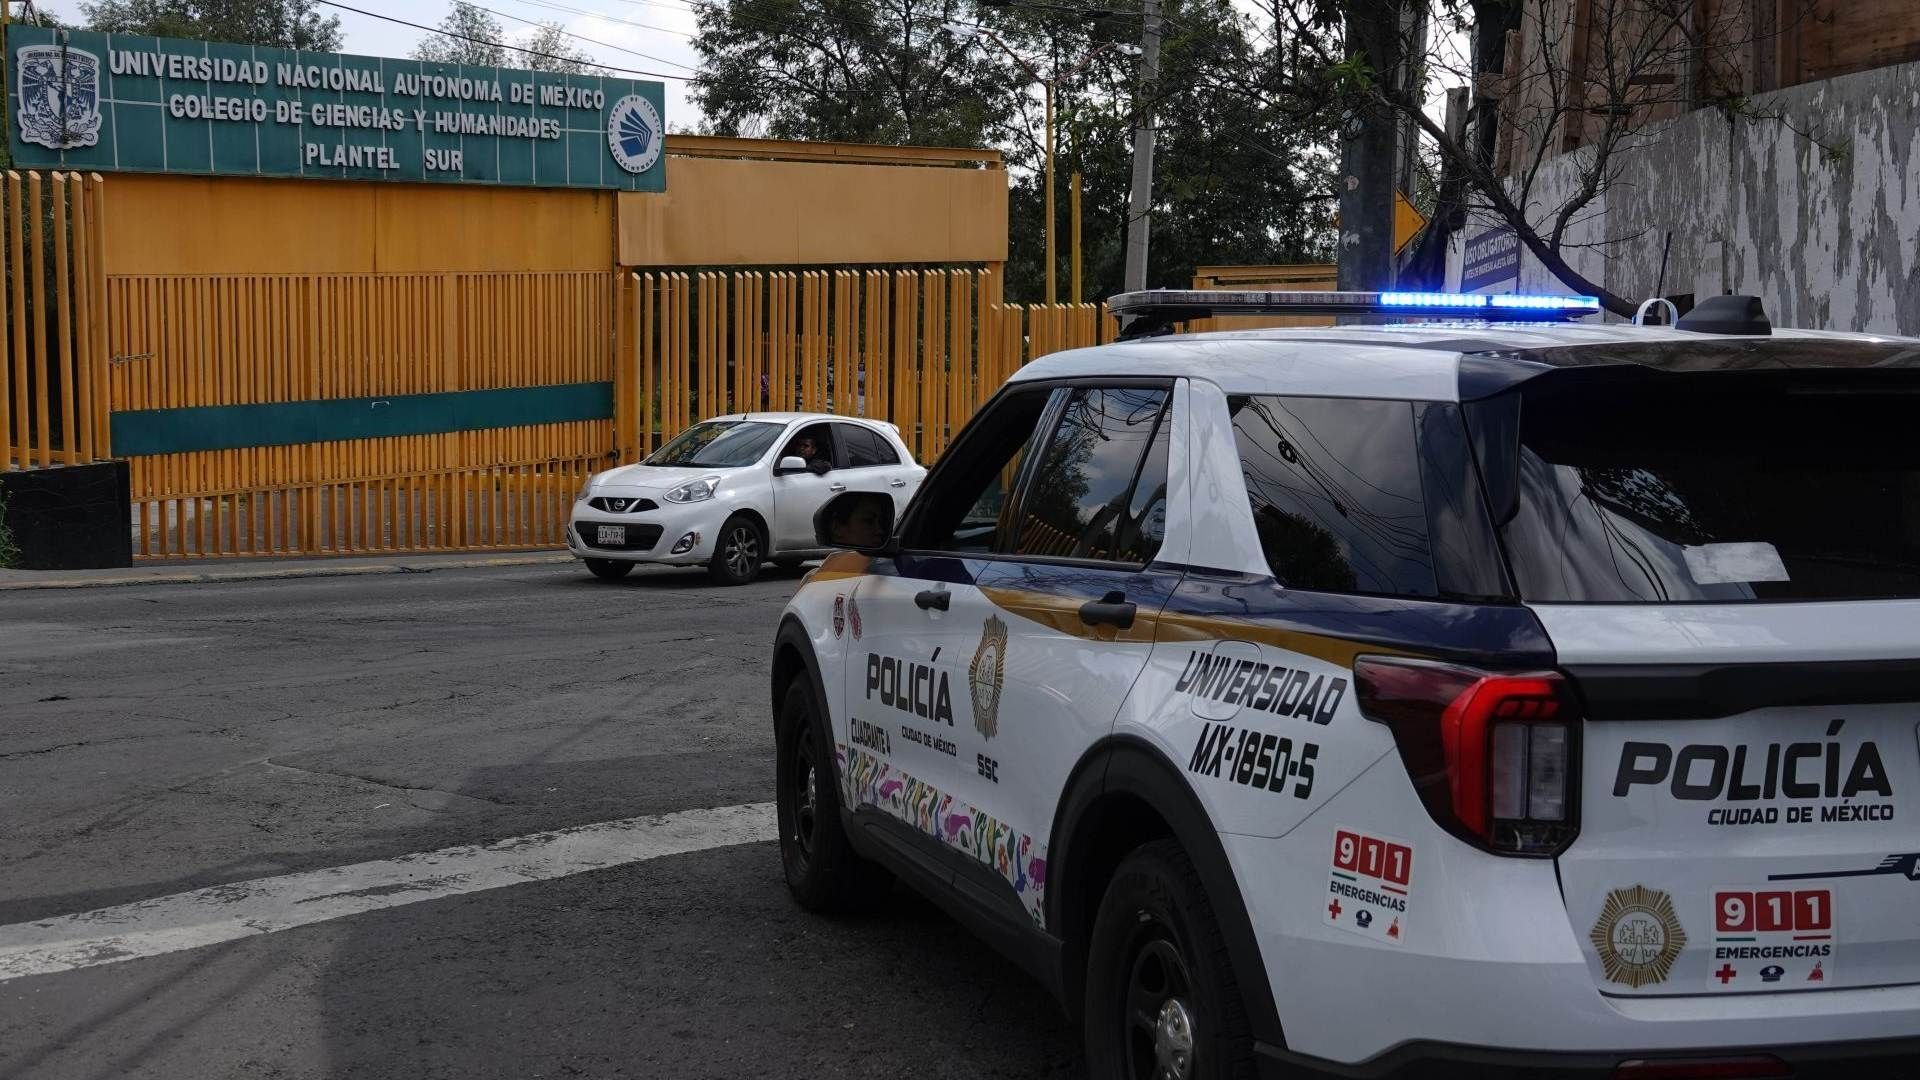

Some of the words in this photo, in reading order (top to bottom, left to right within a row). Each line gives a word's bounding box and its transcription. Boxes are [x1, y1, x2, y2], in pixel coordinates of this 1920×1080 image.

[109, 50, 269, 85] UNIVERSIDAD
[277, 63, 384, 93] NACIONAL
[511, 82, 533, 104] DE
[170, 94, 267, 122] COLEGIO
[276, 100, 302, 124] DE
[312, 103, 405, 131] CIENCIAS
[414, 109, 426, 132] Y
[435, 111, 561, 140] HUMANIDADES
[306, 142, 400, 169] PLANTEL
[425, 148, 463, 172] SUR
[866, 646, 954, 727] POLICÍA
[1175, 650, 1348, 726] UNIVERSIDAD
[901, 725, 922, 744] CIUDAD
[923, 732, 933, 748] DE
[933, 733, 957, 757] MÉXICO
[977, 753, 999, 784] SSC
[1612, 719, 1893, 801] POLICÍA
[1707, 807, 1779, 825] CIUDAD
[1786, 806, 1814, 823] DE
[1820, 799, 1895, 823] MÉXICO
[1337, 834, 1407, 880] 911
[1329, 880, 1407, 913] EMERGENCIAS
[1722, 895, 1823, 927] 911
[1716, 944, 1832, 960] EMERGENCIAS
